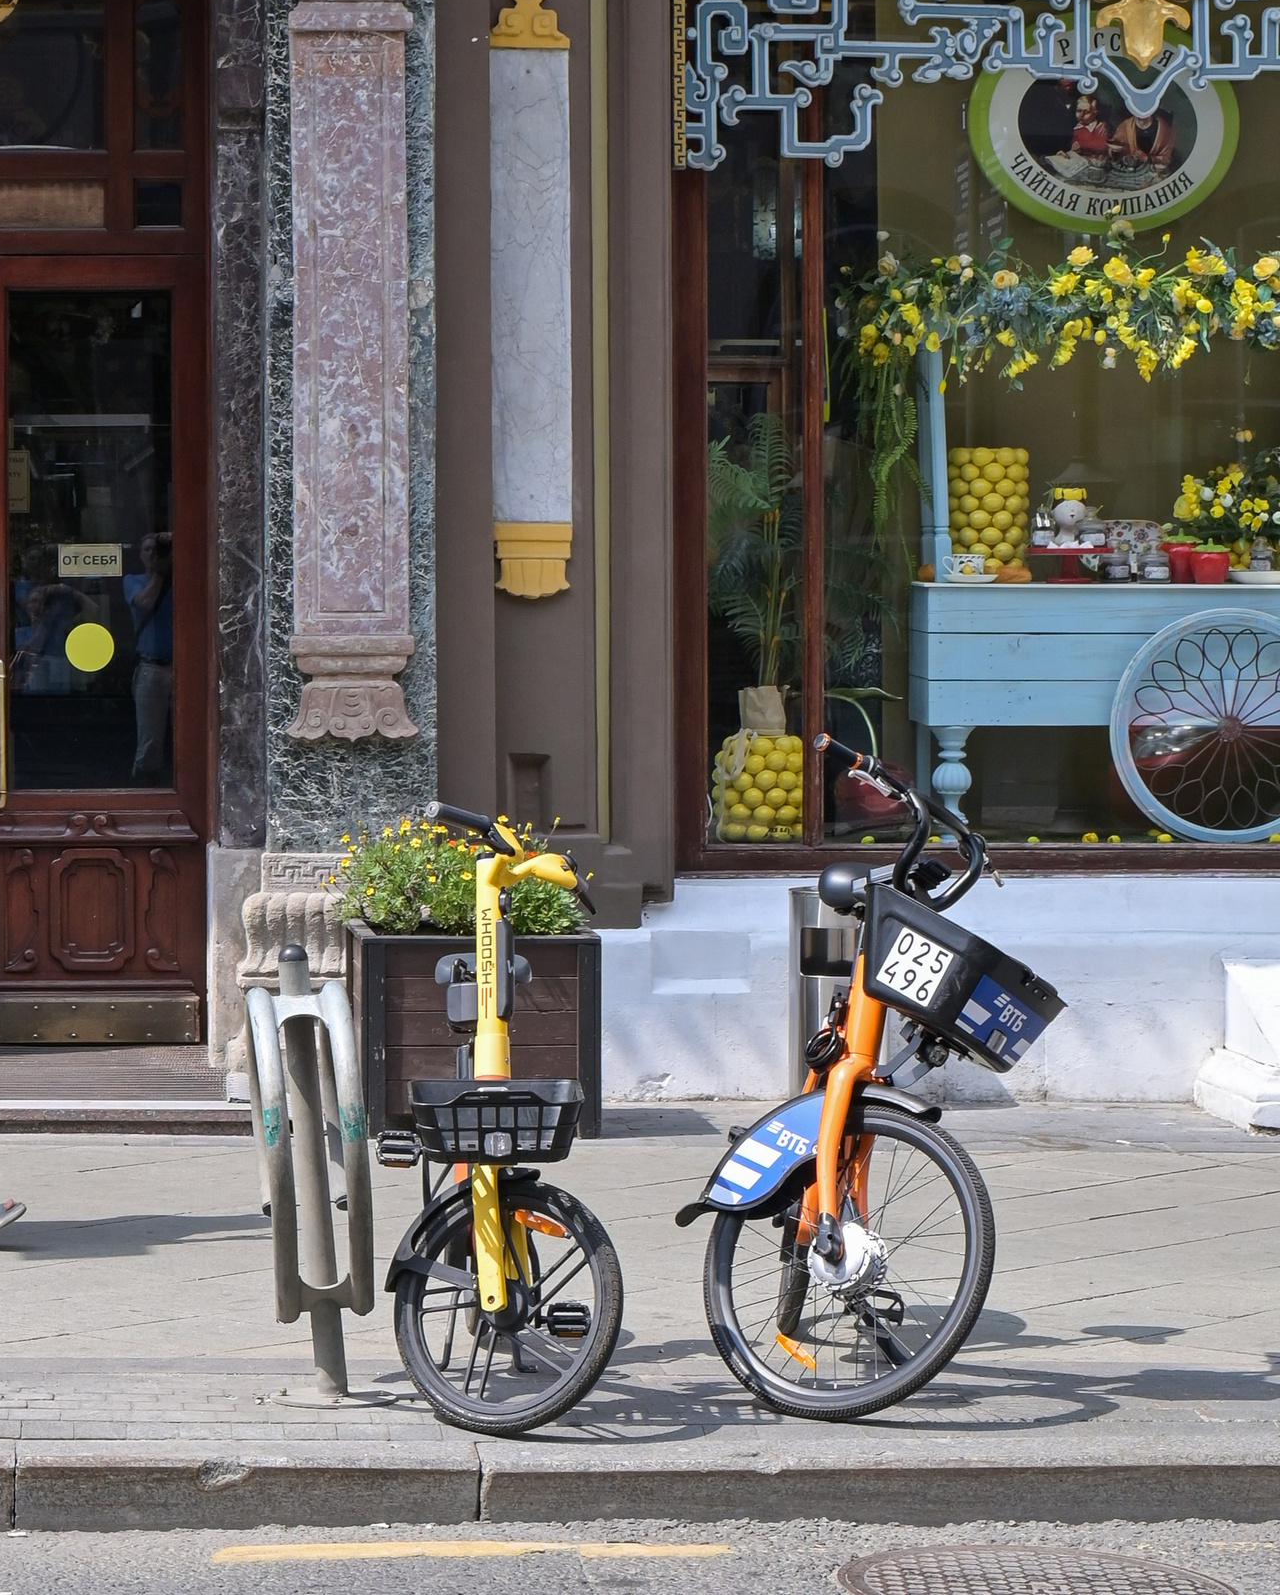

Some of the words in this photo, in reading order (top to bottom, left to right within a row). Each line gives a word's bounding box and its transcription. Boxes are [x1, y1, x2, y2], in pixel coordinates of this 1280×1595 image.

[1010, 152, 1082, 212] ЧАЙНАЯ
[1085, 171, 1195, 217] КОМПАНИЯ
[62, 555, 79, 565] ОТ
[82, 555, 118, 566] СЕБЯ
[481, 908, 492, 985] WHOOSH
[897, 932, 949, 975] 025
[883, 961, 933, 1002] 496
[998, 1003, 1028, 1033] ВТБ
[775, 1129, 811, 1156] ВТБ
